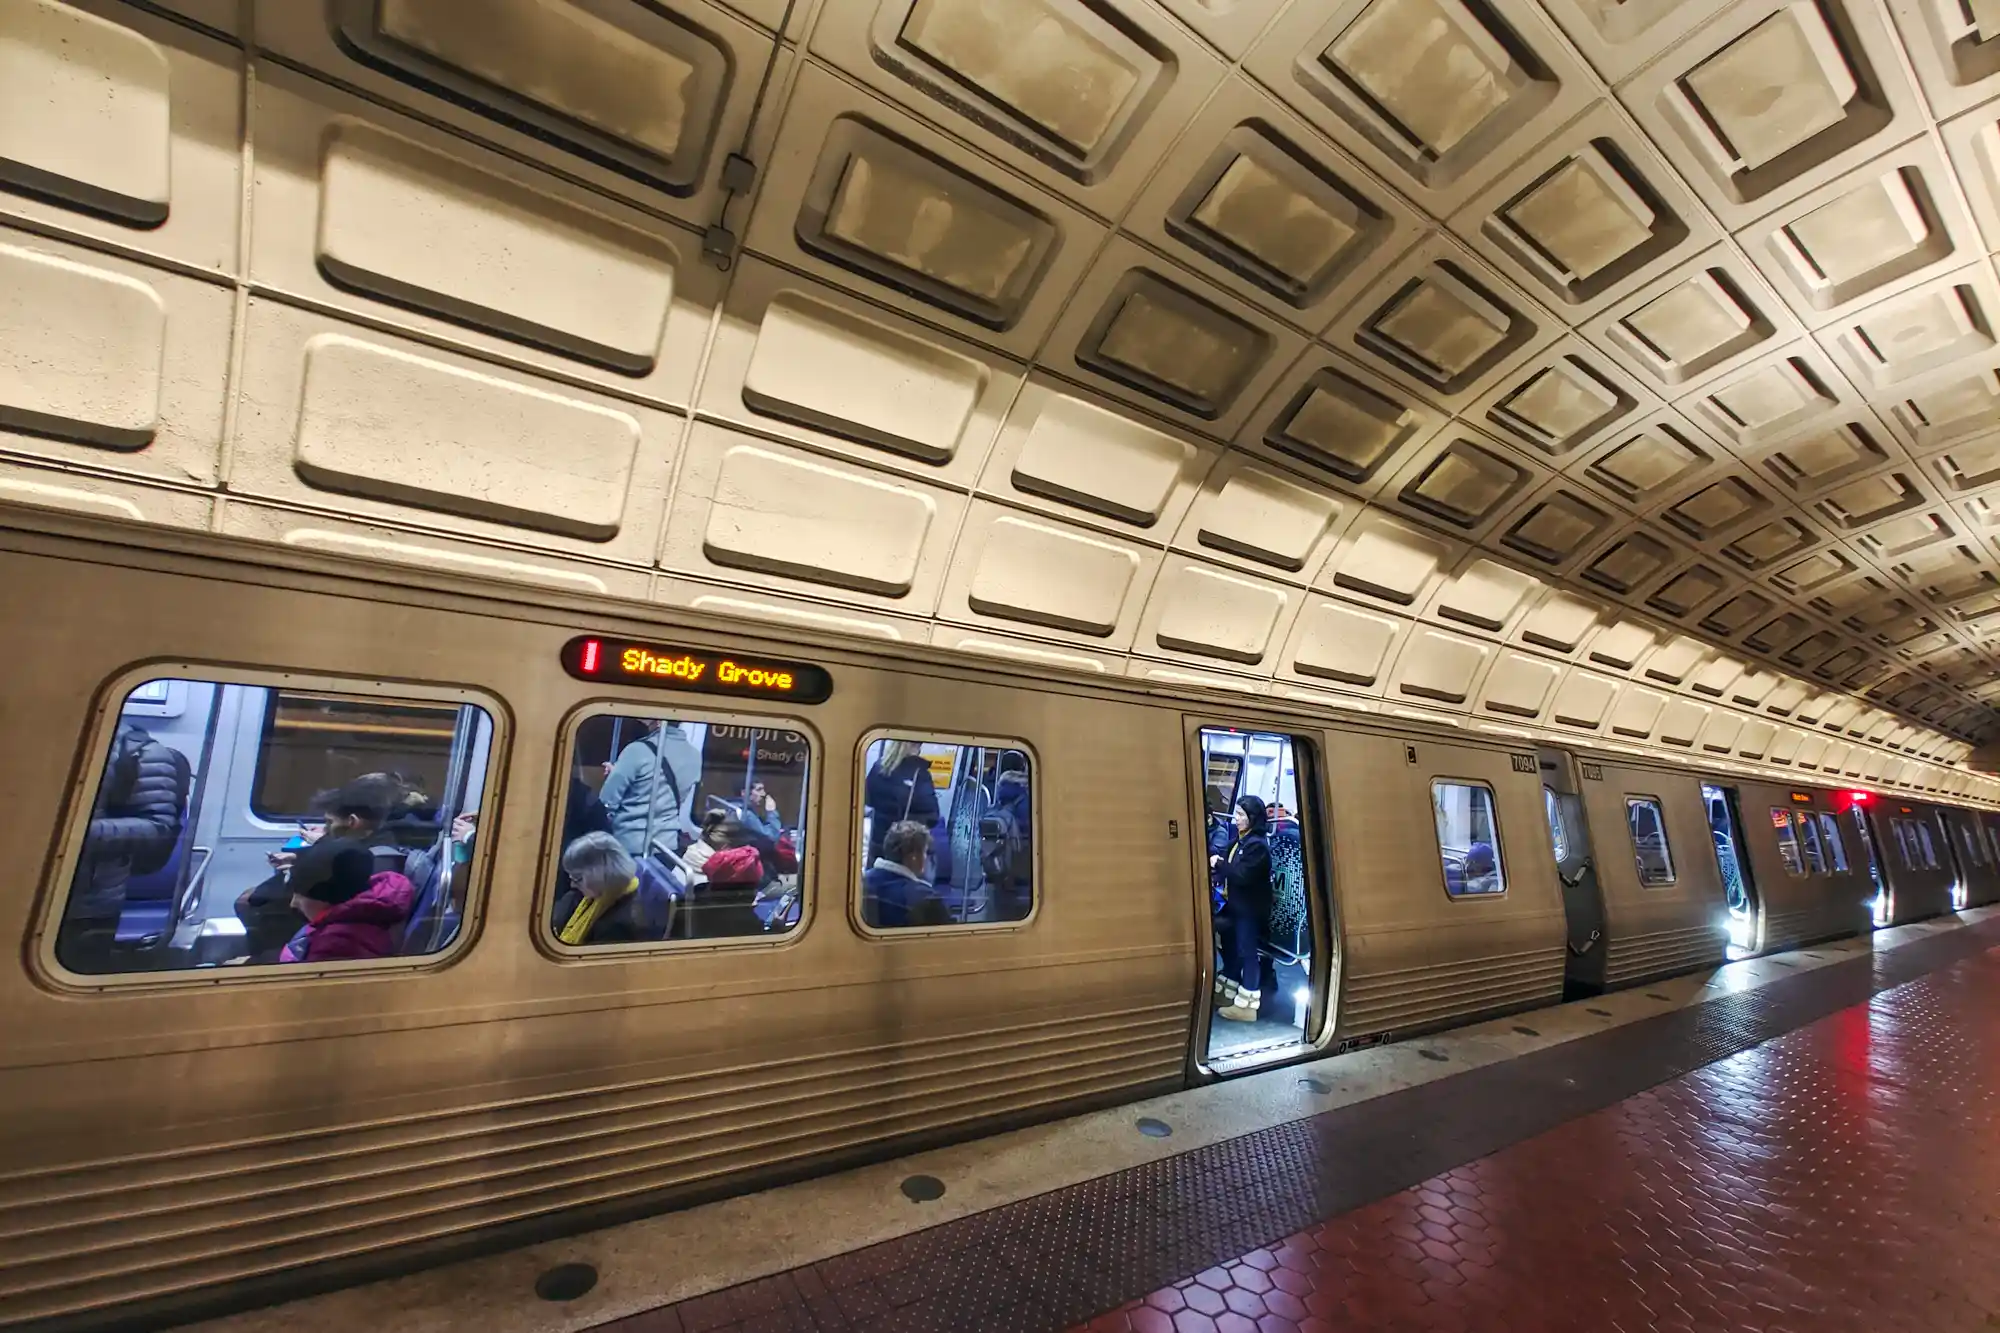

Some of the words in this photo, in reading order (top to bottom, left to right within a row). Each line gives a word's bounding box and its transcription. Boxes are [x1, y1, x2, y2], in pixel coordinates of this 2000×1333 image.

[622, 648, 705, 680] Shady
[718, 661, 793, 690] Grove
[785, 731, 806, 744] S
[756, 748, 792, 764] Shady
[1512, 755, 1535, 772] 7094
